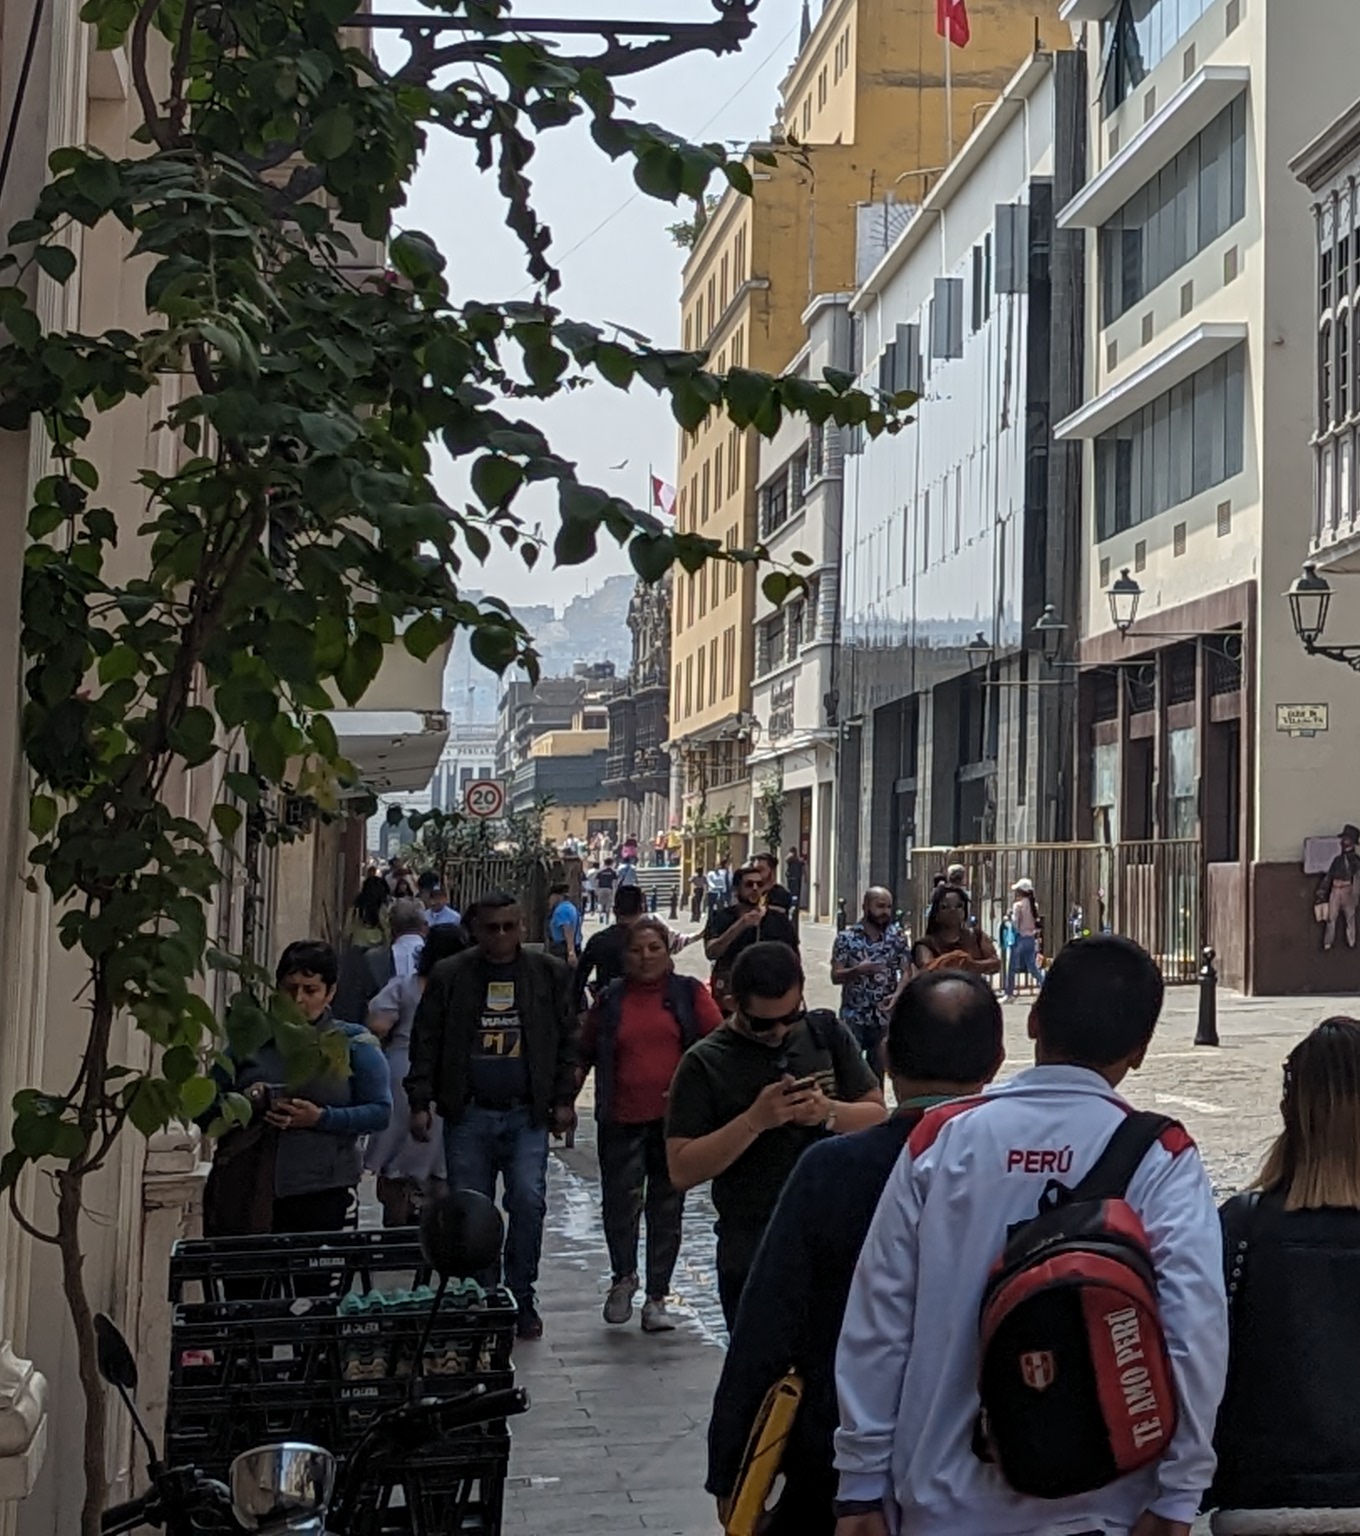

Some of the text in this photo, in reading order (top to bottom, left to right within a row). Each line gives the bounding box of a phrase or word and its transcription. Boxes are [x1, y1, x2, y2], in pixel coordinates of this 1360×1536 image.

[472, 790, 497, 805] 20
[1006, 1145, 1074, 1174] PERÚ
[1103, 1307, 1164, 1449] TE AMO PERÚ
